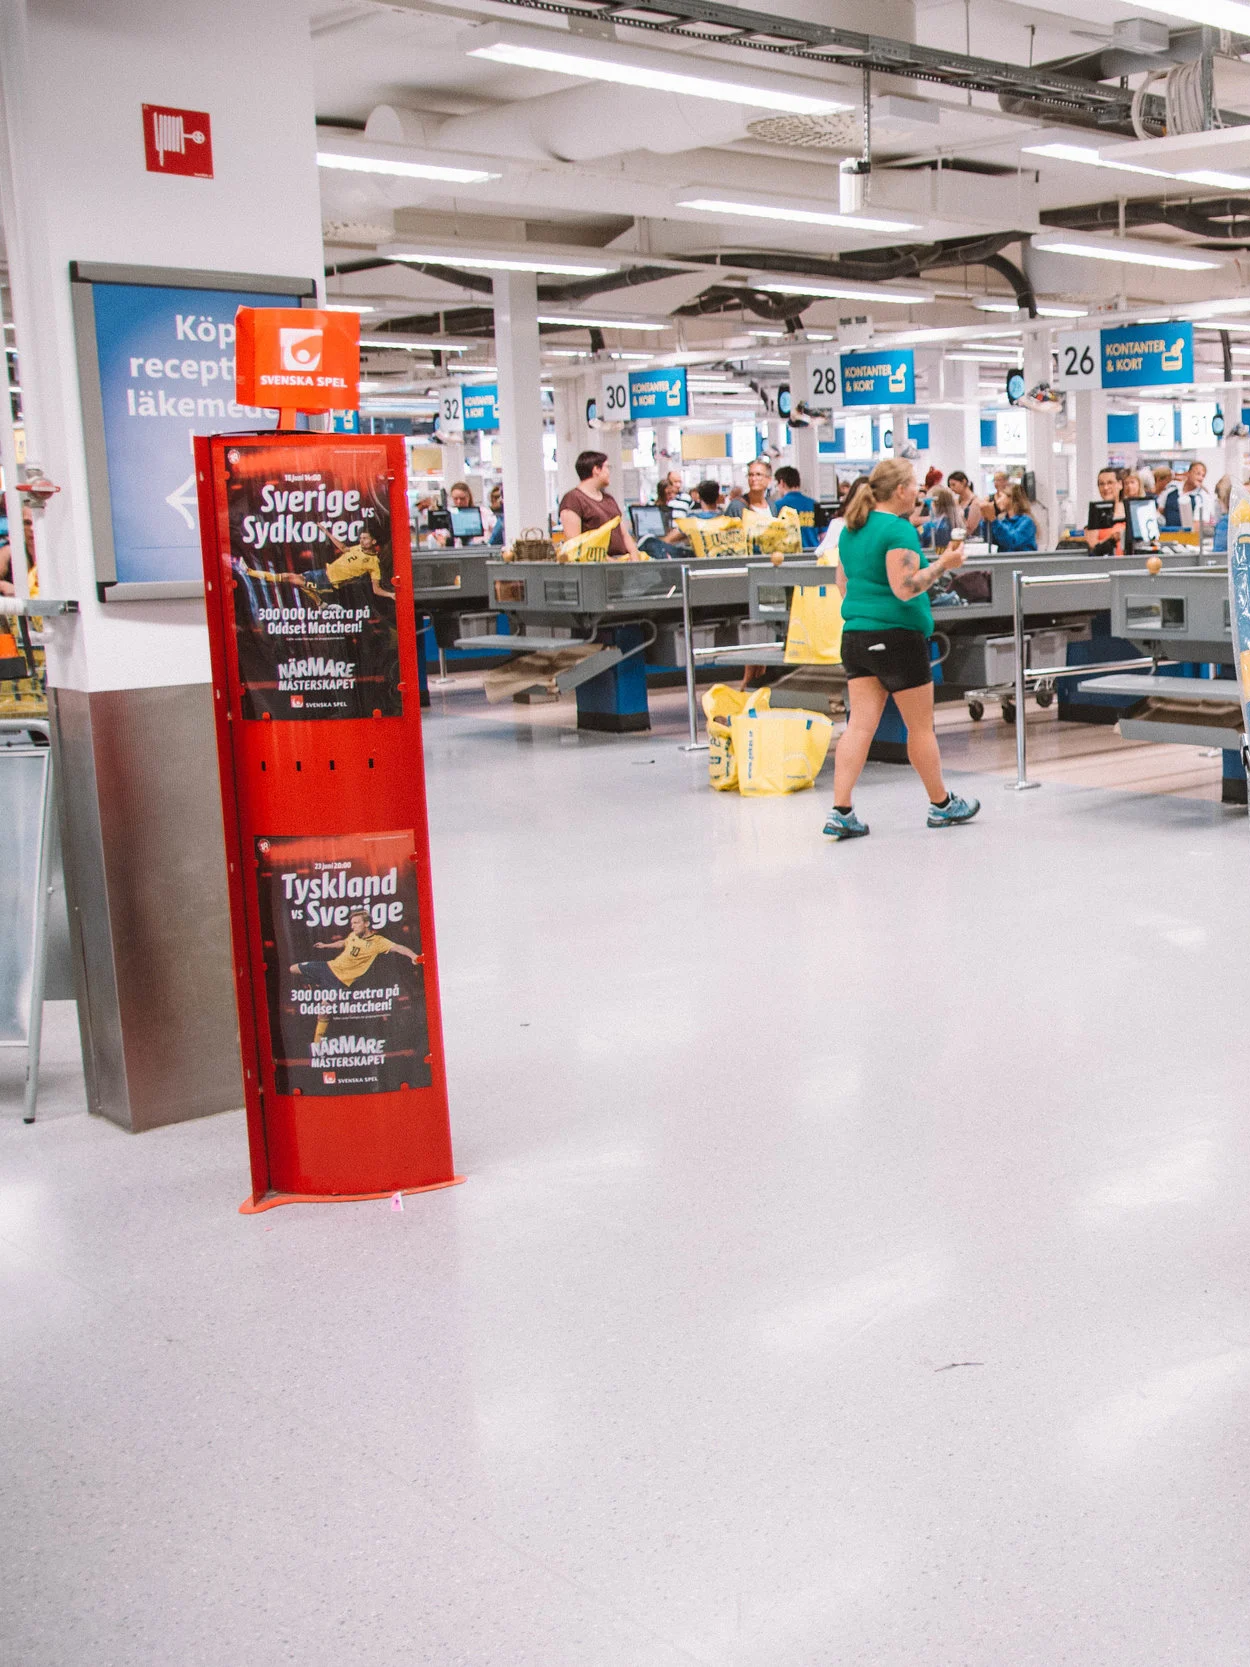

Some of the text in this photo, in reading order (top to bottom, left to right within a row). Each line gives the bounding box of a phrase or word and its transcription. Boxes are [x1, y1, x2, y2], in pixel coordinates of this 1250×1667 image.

[175, 314, 236, 349] Köp
[1105, 339, 1166, 356] KONTANTER
[1064, 345, 1095, 376] 26
[1106, 357, 1143, 372] & KORT
[129, 355, 237, 387] recept
[844, 363, 892, 379] KONTANTER
[260, 374, 349, 389] SVENSKA SPEL
[812, 367, 837, 395] 28
[845, 379, 875, 392] & KORT
[606, 384, 626, 409] 30
[443, 399, 460, 420] 32
[1145, 417, 1168, 438] 32
[1190, 415, 1209, 436] 31
[260, 483, 375, 518] Sverige vs
[242, 514, 365, 550] Sydkorea
[258, 605, 371, 621] 300 000 kr extra på
[267, 620, 363, 635] Oddset Matchen!
[278, 657, 356, 679] NÄRMARE
[279, 679, 356, 691] MÄSTERSKAPET
[322, 862, 333, 871] juni
[281, 867, 398, 905] Tyskland
[291, 909, 304, 920] vs
[290, 984, 400, 1002] 300 000 kr extra på
[300, 998, 393, 1015] Oddset Matchen!
[310, 1035, 386, 1057] NÄRMARE
[311, 1055, 387, 1068] MÄSTERSKAPET
